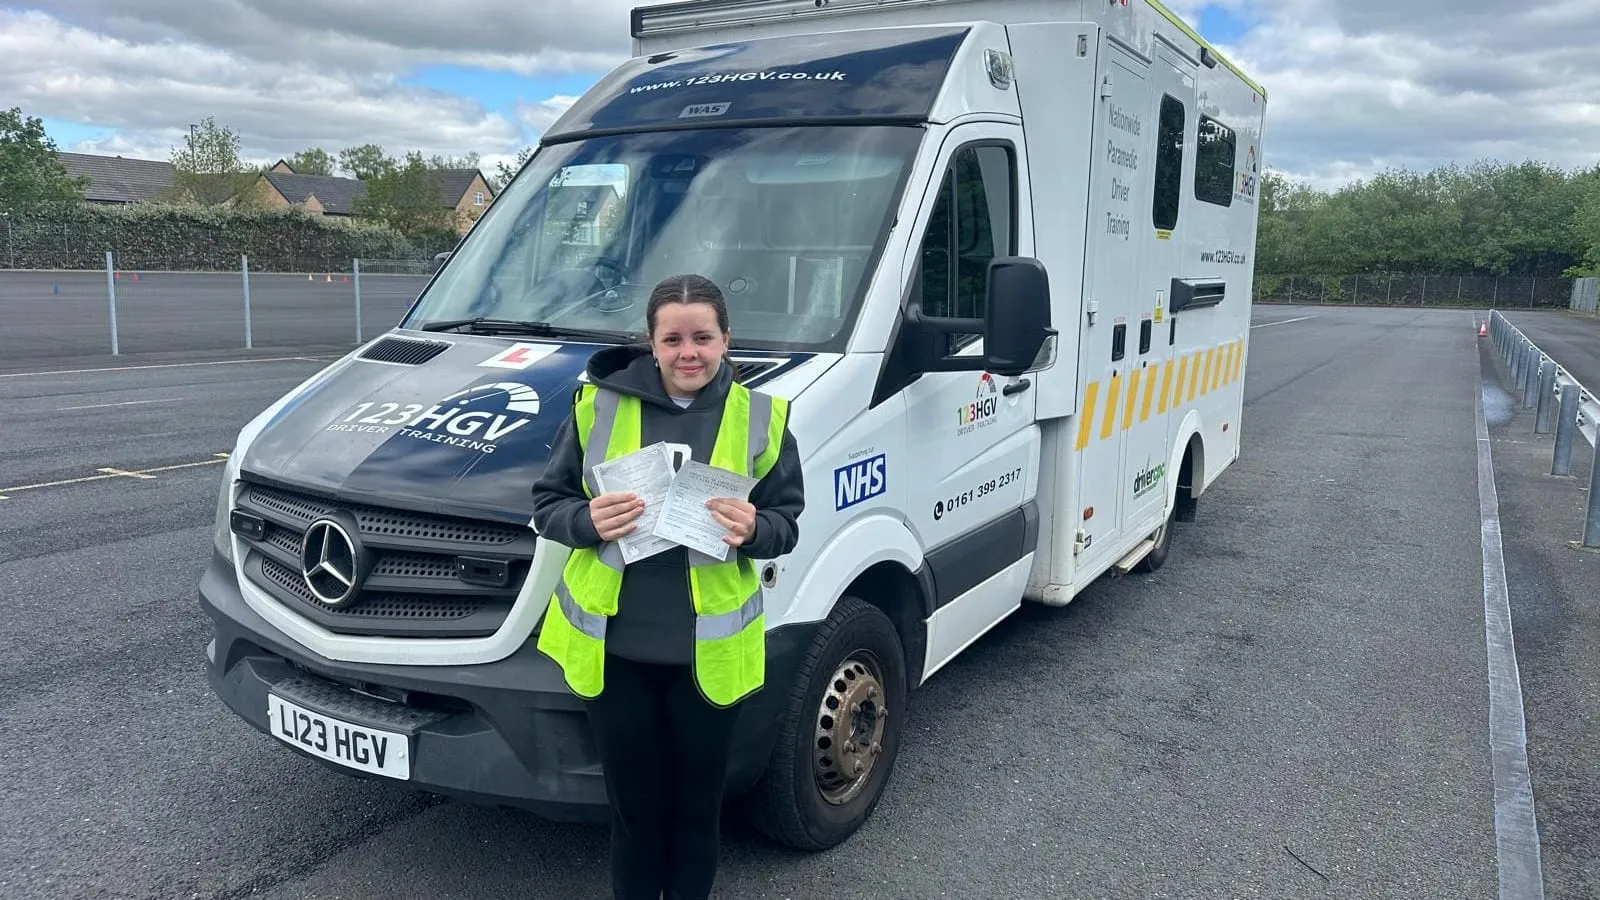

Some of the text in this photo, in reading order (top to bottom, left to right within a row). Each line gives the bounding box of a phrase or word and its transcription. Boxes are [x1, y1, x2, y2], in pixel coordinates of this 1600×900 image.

[630, 71, 847, 94] www.123HGV.co.uk
[689, 105, 721, 115] WAS
[1109, 103, 1141, 137] Nationwide
[1107, 139, 1137, 170] Paramedic
[1112, 177, 1129, 201] Driver
[1107, 212, 1130, 240] Training
[1200, 249, 1246, 264] www.123HGV.co.uk
[498, 347, 532, 364] L
[344, 401, 532, 442] 123HGV
[957, 396, 997, 426] 123HGV
[325, 424, 497, 454] DRIVER TRAINING
[957, 424, 975, 437] DRIVER
[837, 457, 885, 508] NHS
[947, 468, 1022, 512] 0161 399 2317
[334, 725, 388, 768] HGV
